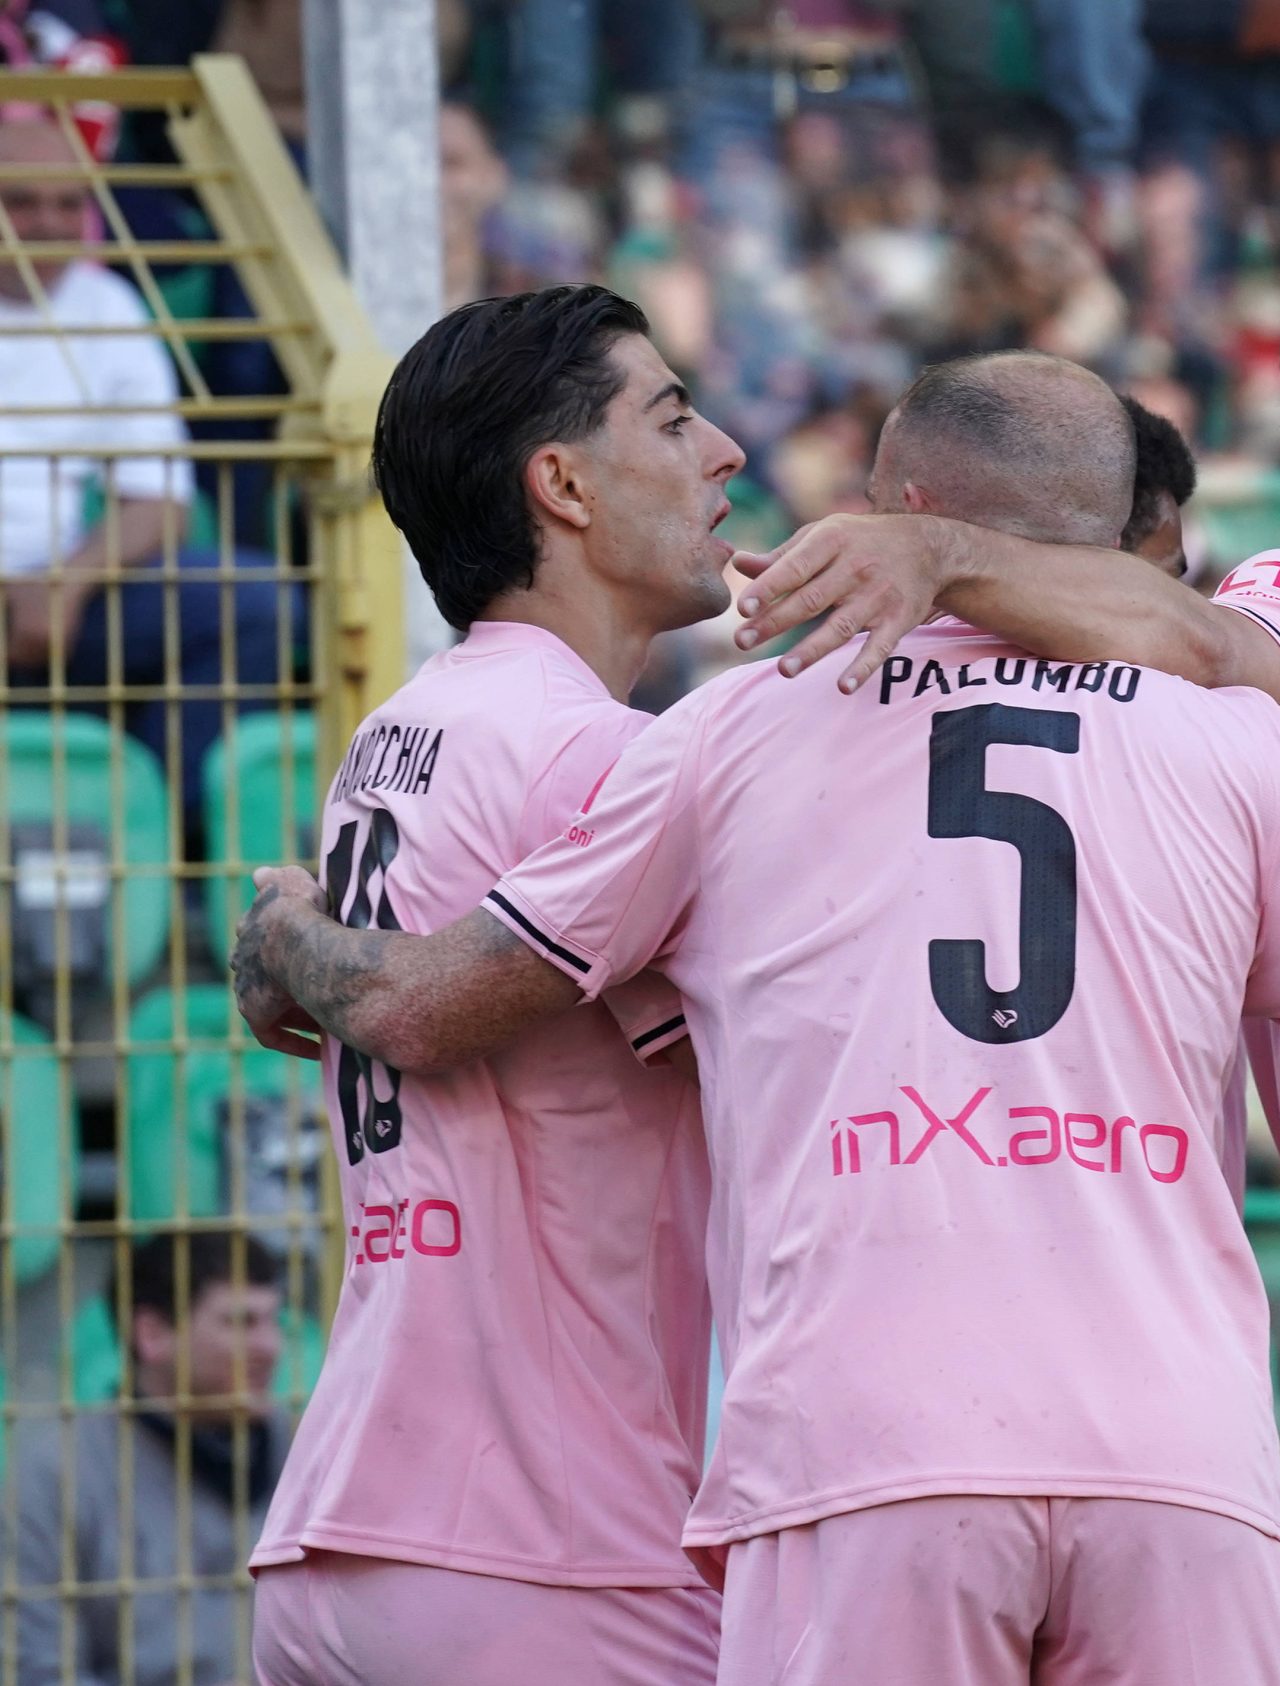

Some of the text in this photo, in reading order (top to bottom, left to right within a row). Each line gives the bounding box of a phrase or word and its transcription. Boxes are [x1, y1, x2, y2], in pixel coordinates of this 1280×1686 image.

[879, 656, 1142, 705] PALUMBO
[928, 702, 1080, 1045] 5
[831, 1085, 1189, 1184] inX.aero
